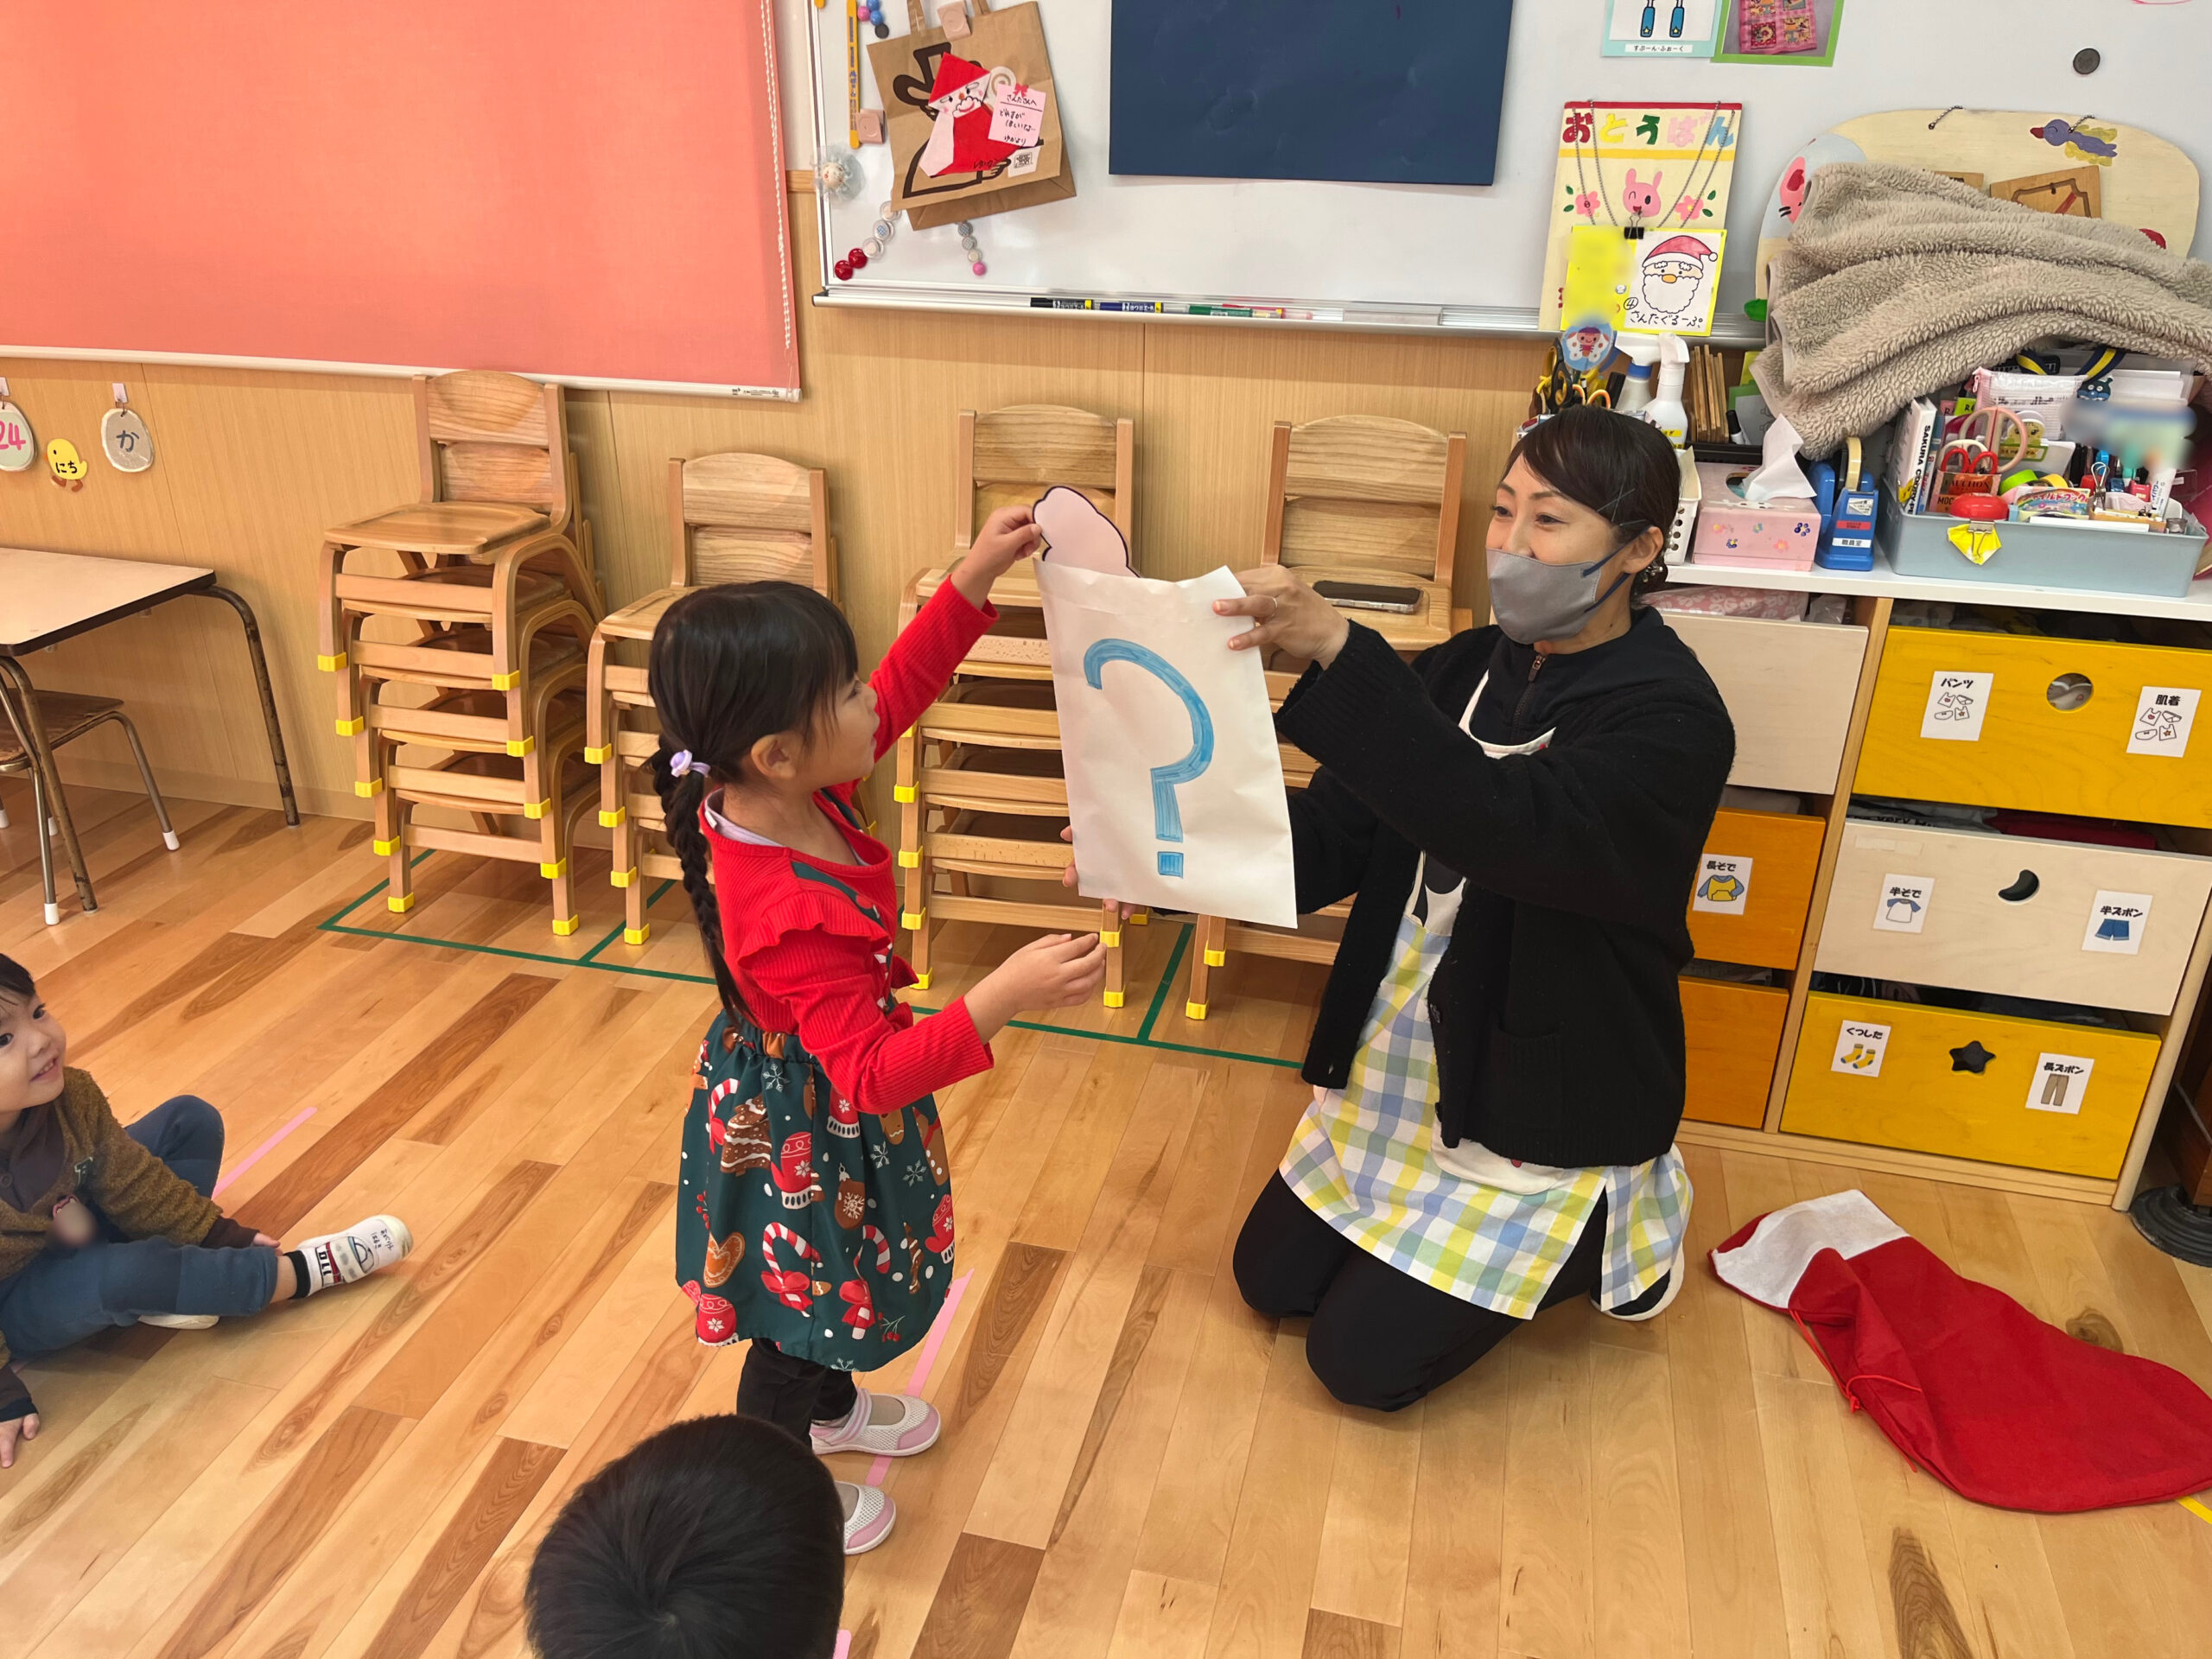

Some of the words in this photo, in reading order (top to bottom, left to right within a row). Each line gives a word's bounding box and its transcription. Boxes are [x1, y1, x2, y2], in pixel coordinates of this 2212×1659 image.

[1561, 111, 1735, 149] おとうばん
[1630, 310, 1704, 328] さんたぐるーぷ
[116, 429, 139, 453] か
[1917, 424, 1931, 466] SAKURA
[55, 461, 78, 474] にち
[1940, 677, 1974, 690] パンツ
[2155, 694, 2181, 706] 肌着
[1706, 860, 1738, 872] 長そで
[1889, 887, 1923, 899] 半そで
[1846, 1027, 1884, 1039] くつした
